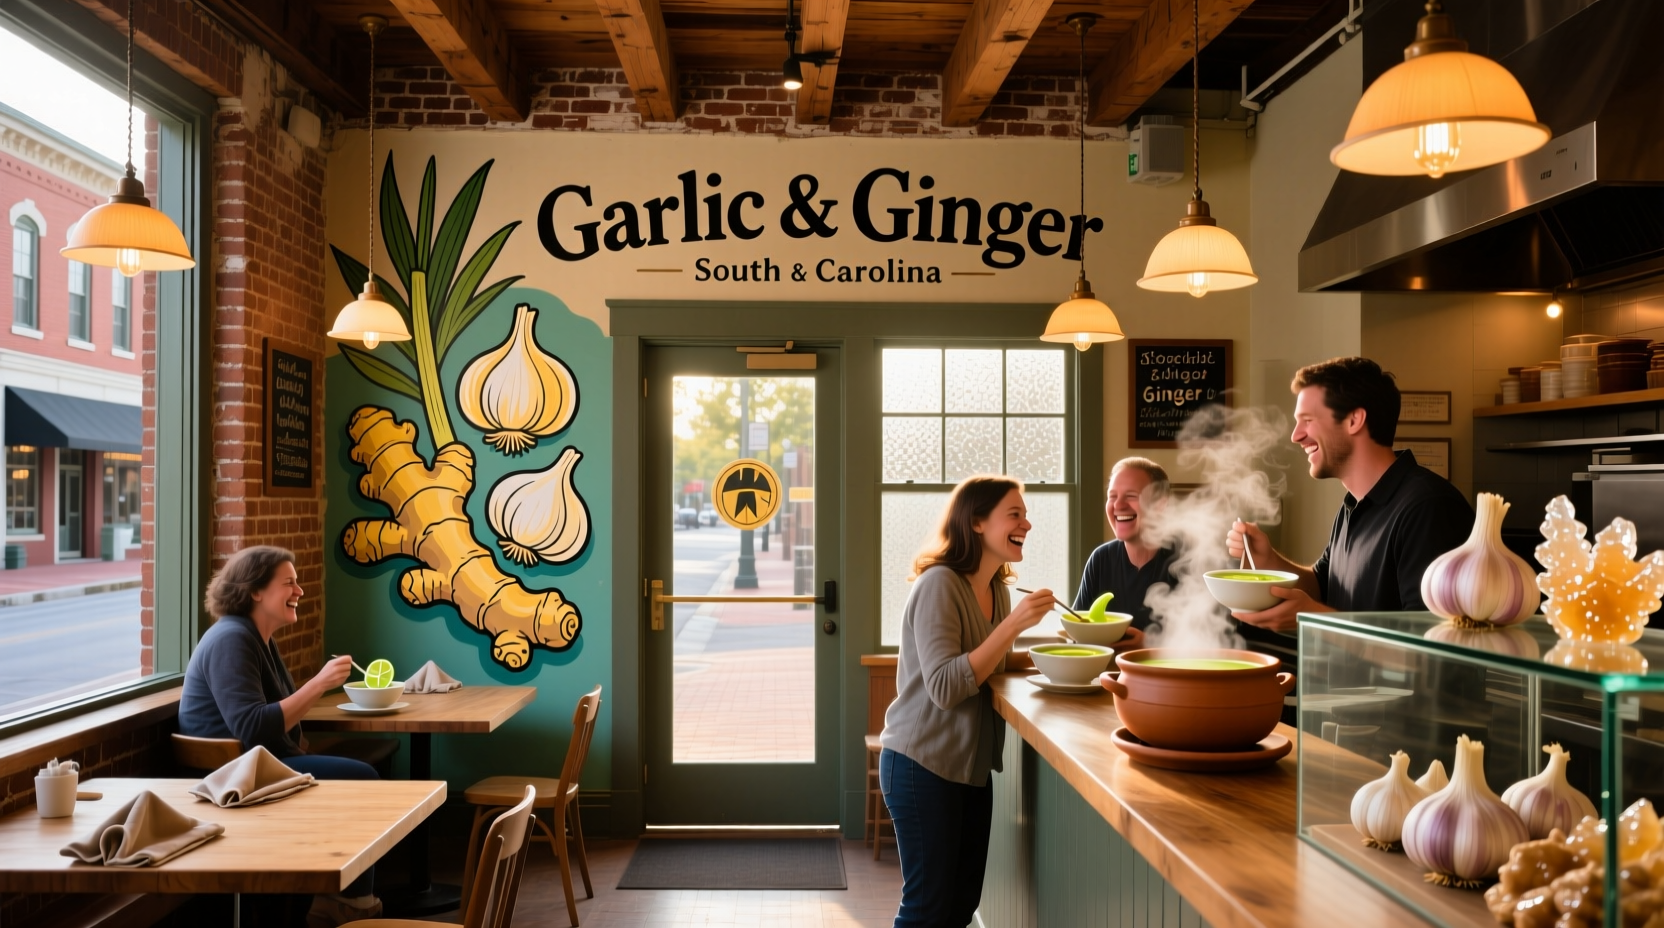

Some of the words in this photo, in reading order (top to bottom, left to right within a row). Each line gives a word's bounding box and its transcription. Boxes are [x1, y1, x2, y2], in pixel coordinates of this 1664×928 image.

[537, 169, 765, 262] Garlic
[779, 173, 839, 238] &
[852, 167, 1104, 269] Ginger
[695, 257, 780, 282] South
[790, 262, 807, 282] &
[815, 258, 942, 283] Carolina
[1143, 386, 1202, 406] Ginger
